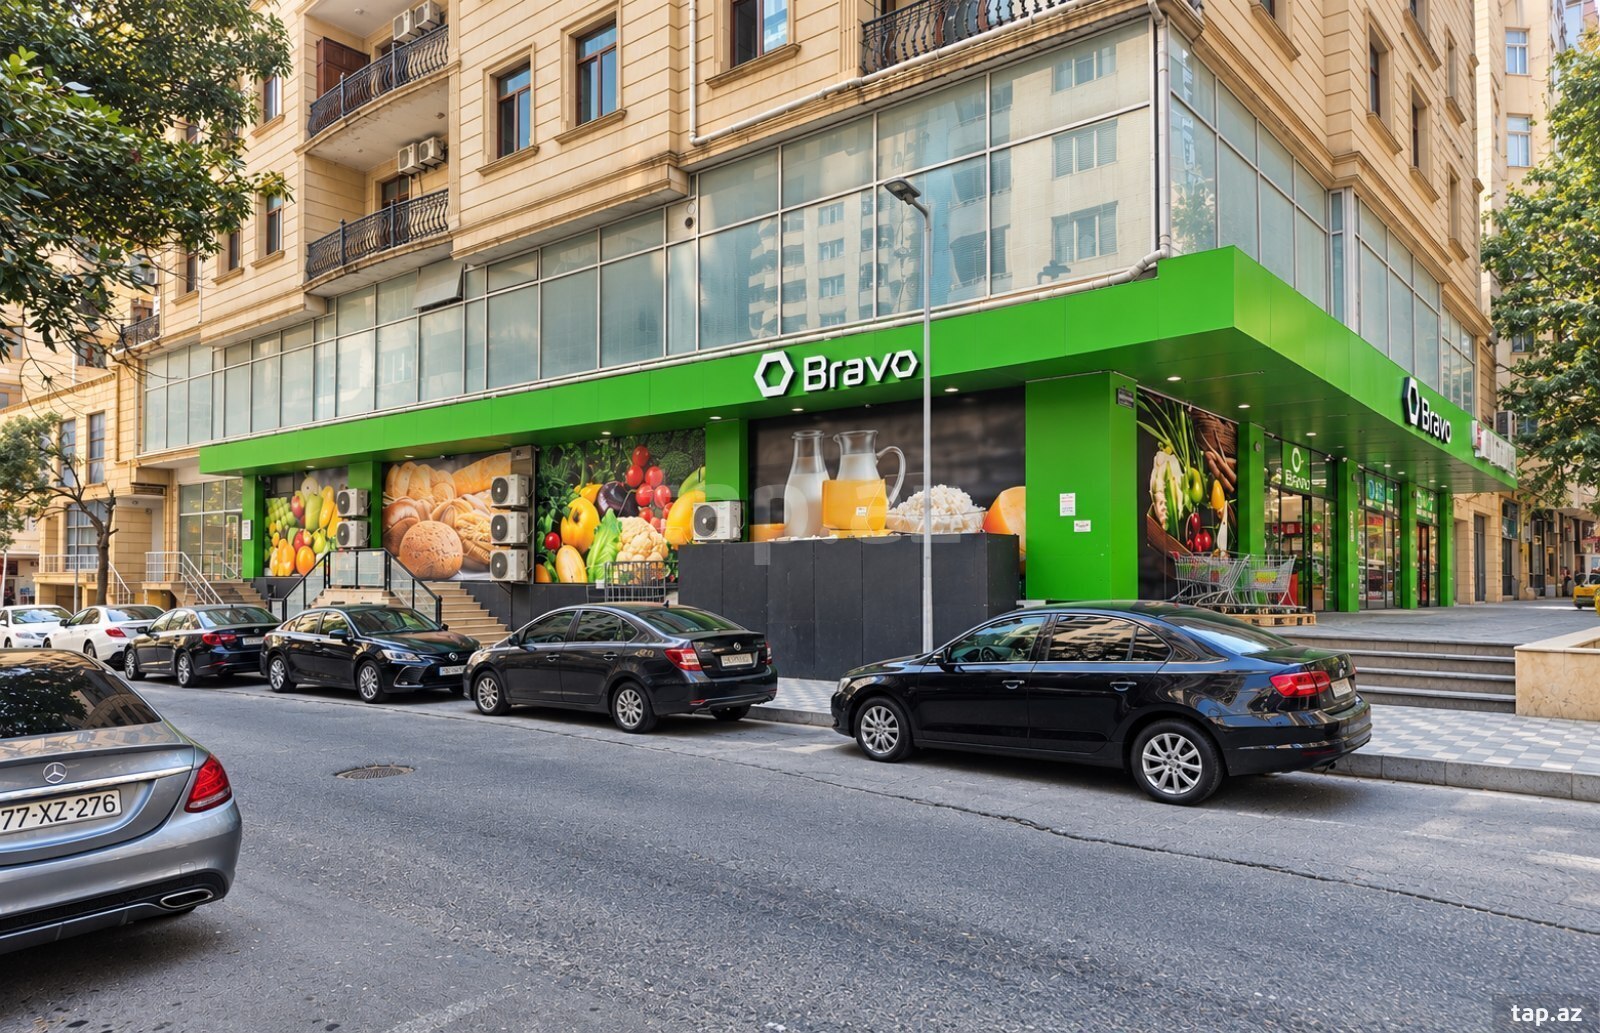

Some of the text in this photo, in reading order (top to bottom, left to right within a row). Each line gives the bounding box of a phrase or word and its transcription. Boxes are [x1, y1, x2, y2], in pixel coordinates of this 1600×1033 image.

[803, 349, 918, 391] Bravo
[1421, 396, 1452, 444] Bravo
[1, 794, 116, 830] 77-XZ-276
